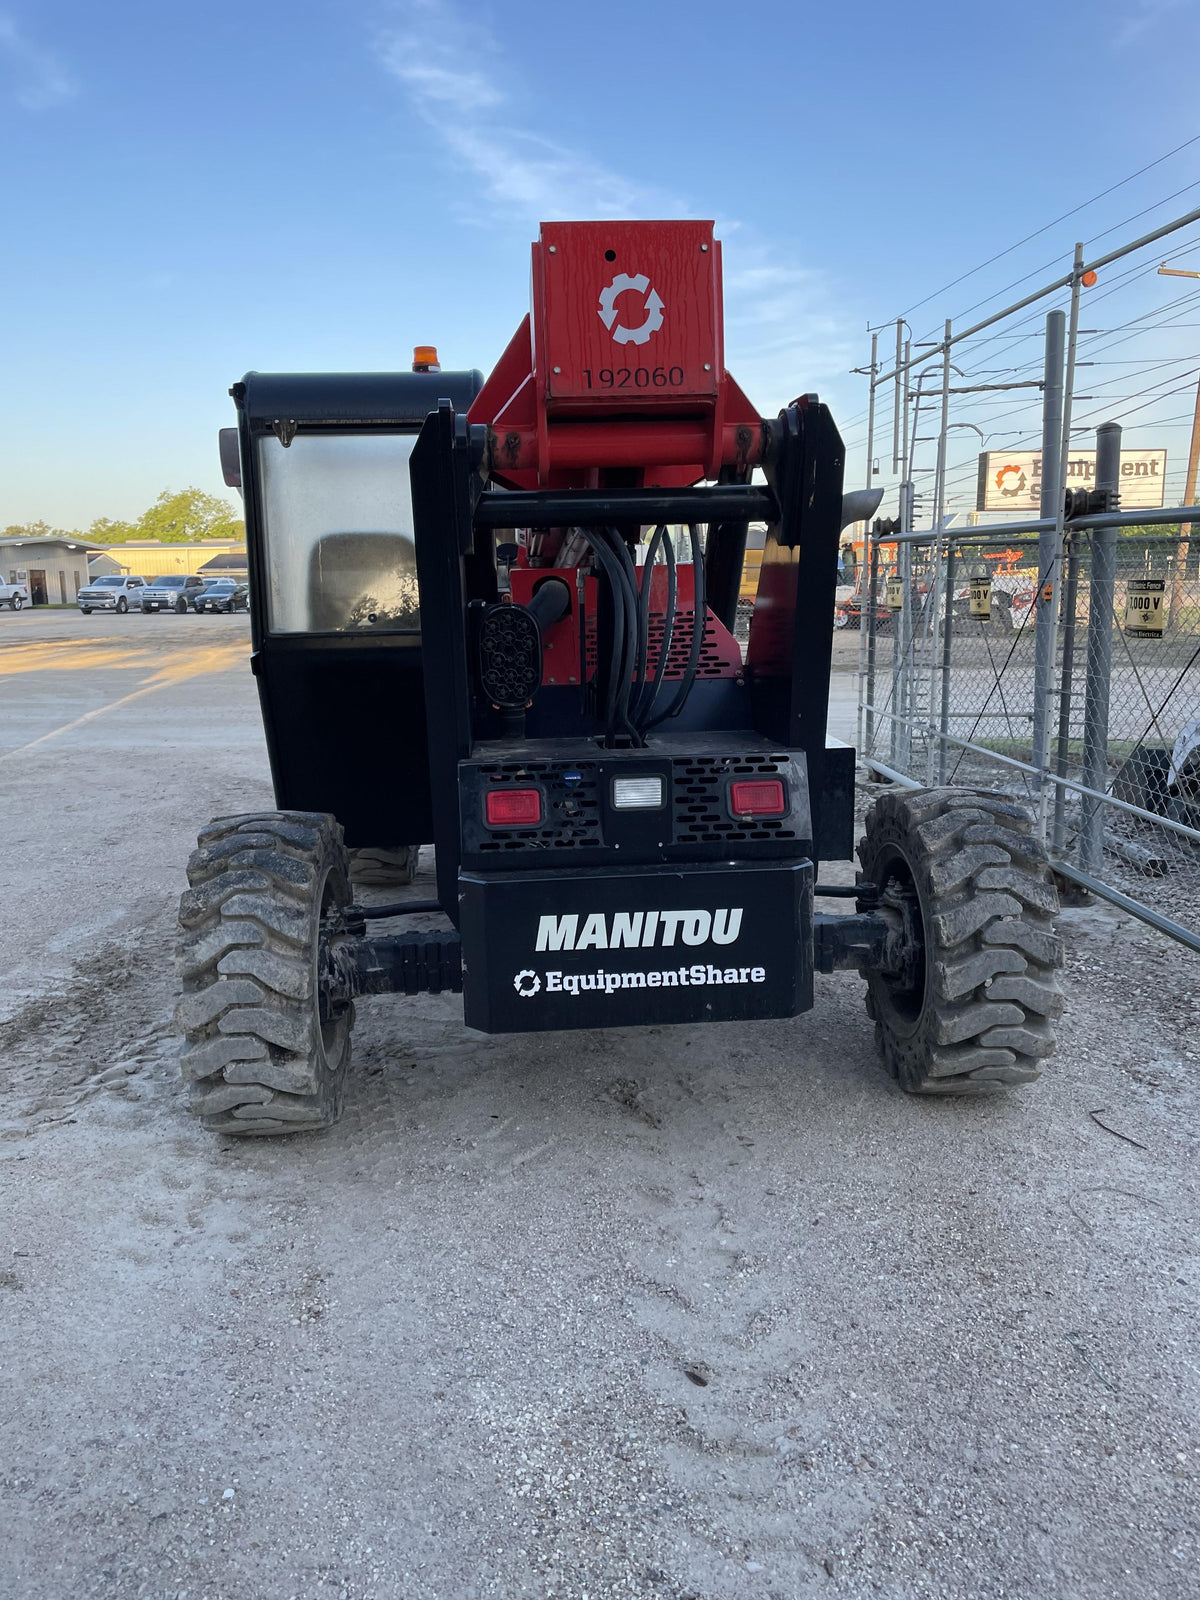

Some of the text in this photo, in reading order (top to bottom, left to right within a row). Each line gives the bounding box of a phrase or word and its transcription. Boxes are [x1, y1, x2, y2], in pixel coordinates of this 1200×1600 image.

[584, 366, 684, 389] 192060
[1031, 459, 1159, 480] Euipent
[1153, 597, 1160, 610] V
[535, 908, 744, 952] MANITOU
[545, 964, 766, 996] EquipmentShare
